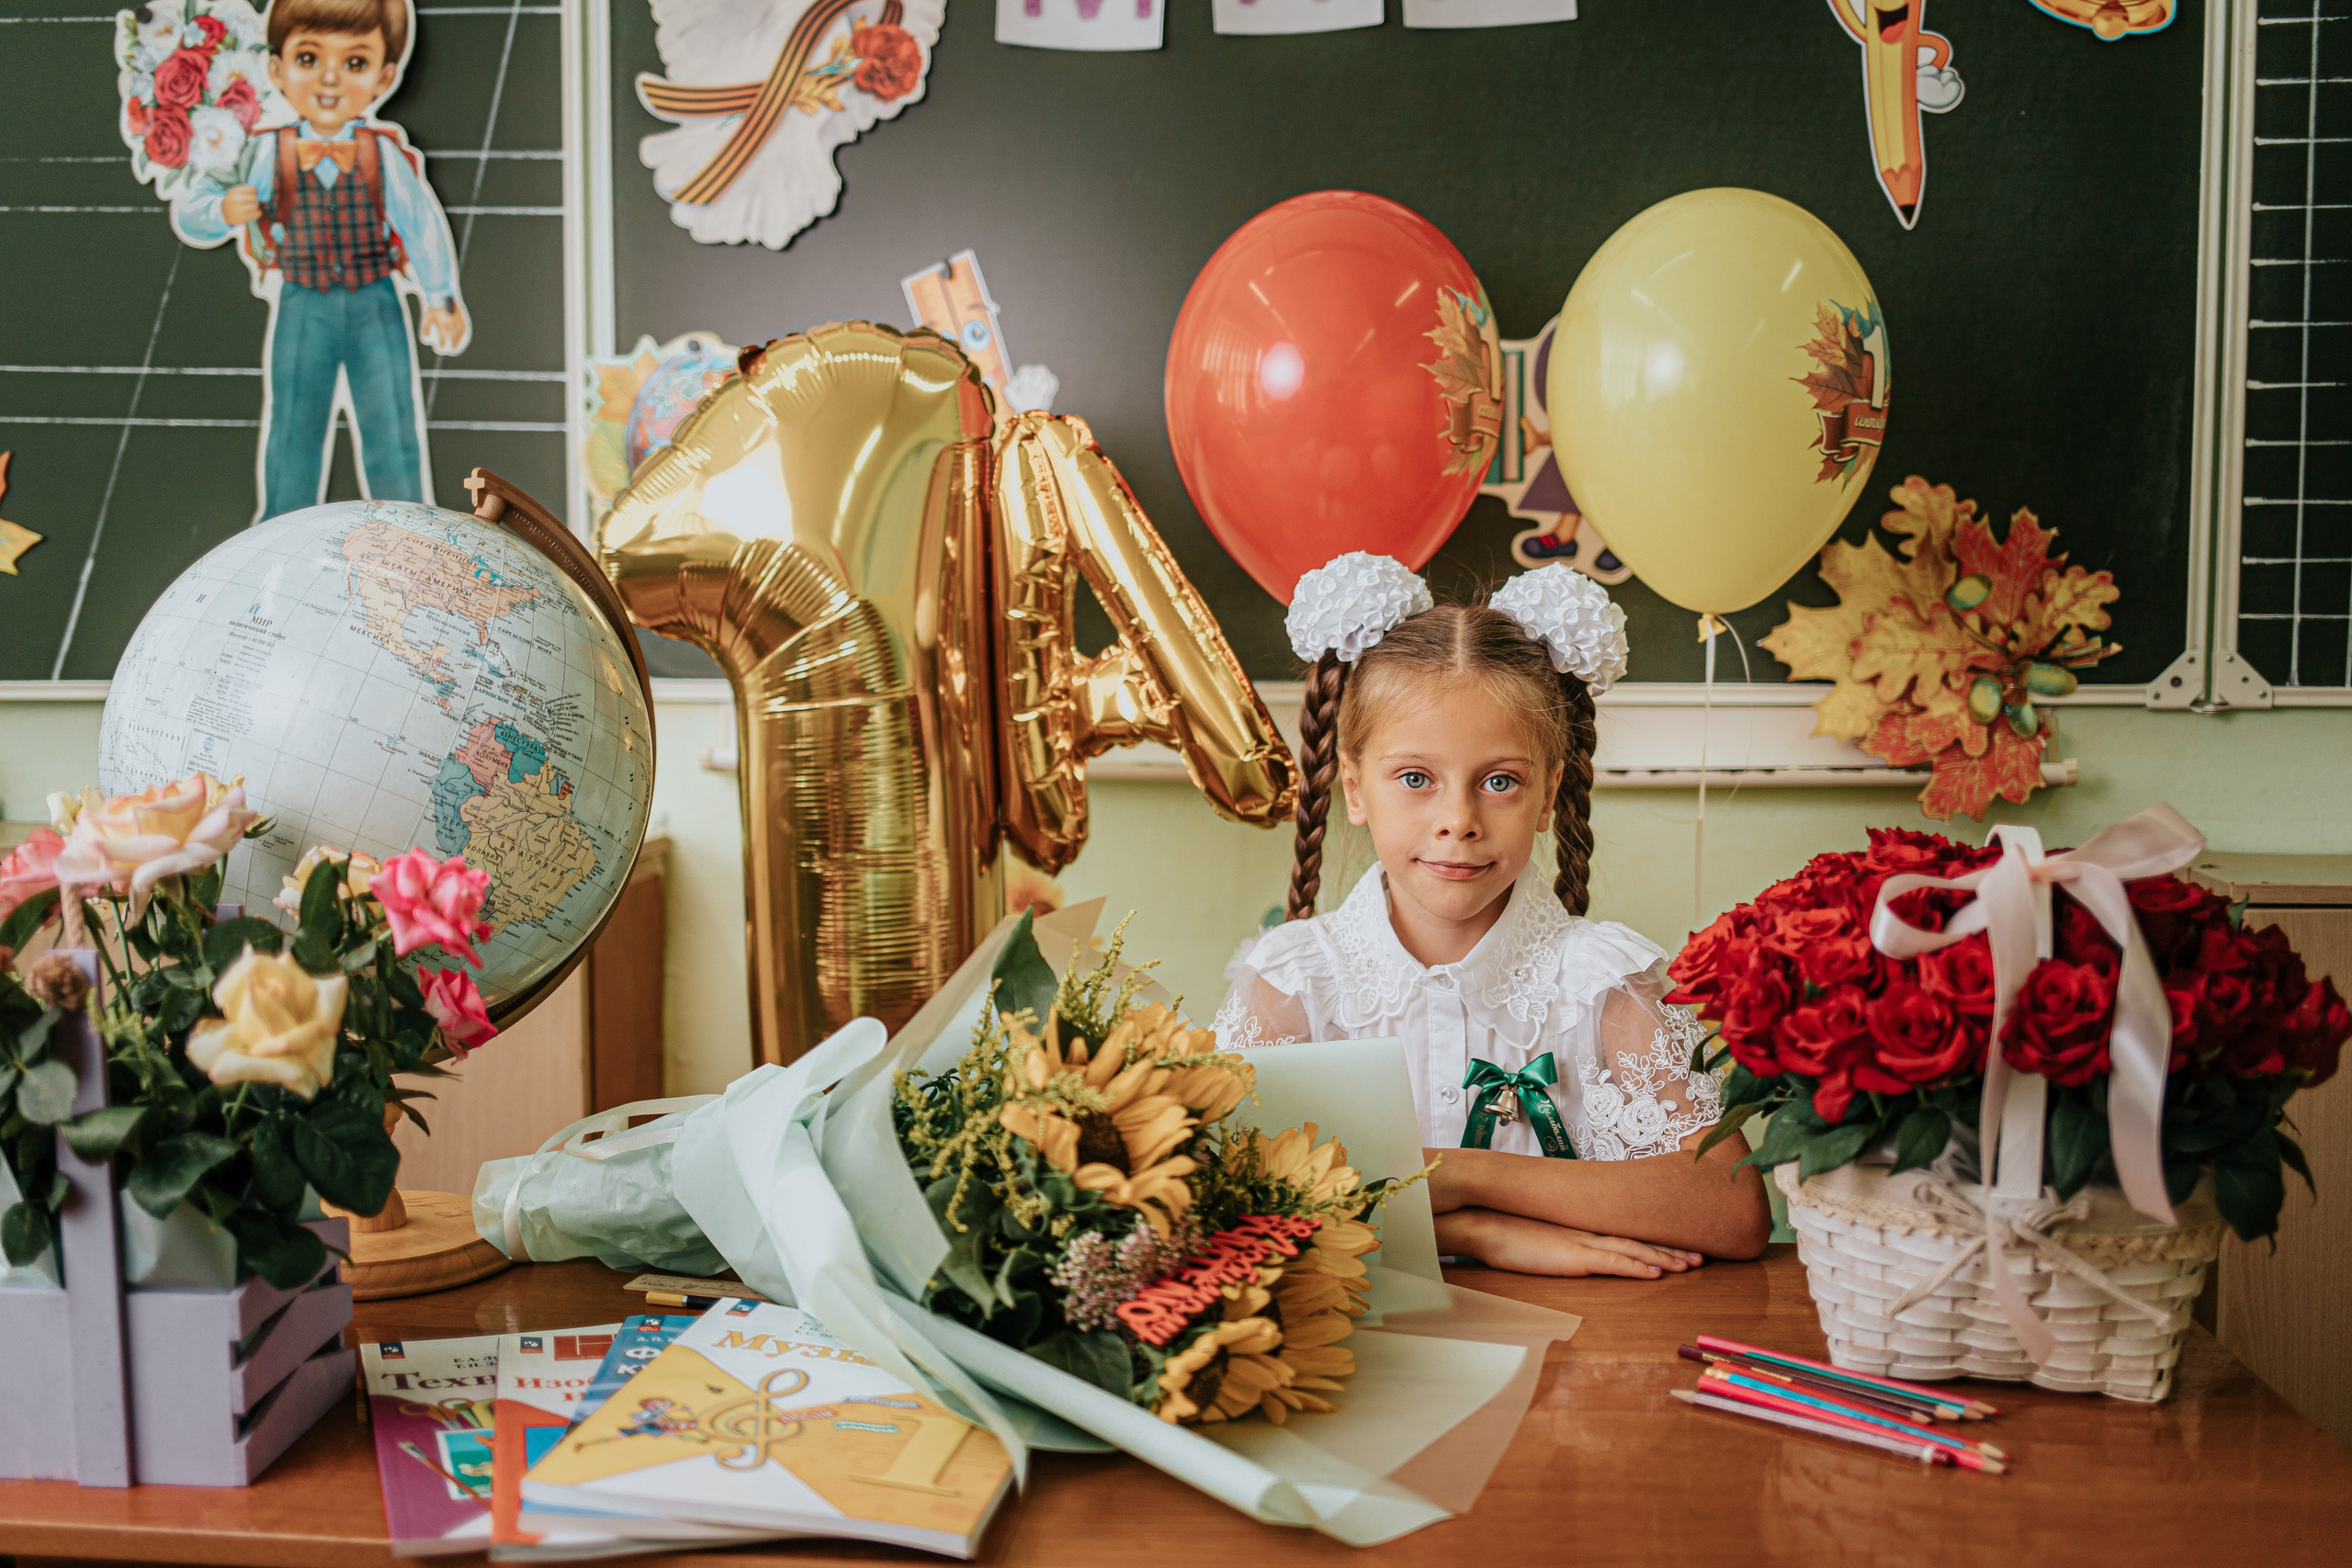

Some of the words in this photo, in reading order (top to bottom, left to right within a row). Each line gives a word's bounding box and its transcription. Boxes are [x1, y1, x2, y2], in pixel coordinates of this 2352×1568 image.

[381, 559, 418, 576] ШТАТЫ
[425, 575, 473, 598] АМЕРИКИ
[229, 620, 268, 635] политический
[267, 631, 288, 641] глобус
[250, 615, 274, 627] МИР
[425, 614, 471, 637] Мексиканский
[229, 630, 249, 641] Масштаб
[349, 625, 390, 645] МЕКСИКА
[432, 626, 450, 636] залив
[497, 626, 535, 648] САРГАССОВО
[537, 644, 553, 656] МОРЕ
[394, 656, 421, 670] ГВАТЕМАЛА
[473, 684, 510, 705] КАРИБСКОЕ
[511, 702, 528, 714] МОРЕ
[347, 715, 359, 724] 100
[500, 729, 538, 752] ВЕНЕСУЭЛА
[419, 750, 442, 762] ЭКВАДОР
[476, 750, 509, 769] КОЛУМБИЯ
[125, 765, 170, 784] Полинезия
[443, 817, 468, 830] ПЕРУ
[467, 843, 501, 862] БОЛИВИЯ
[500, 842, 565, 876] БРАЗИЛИЯ
